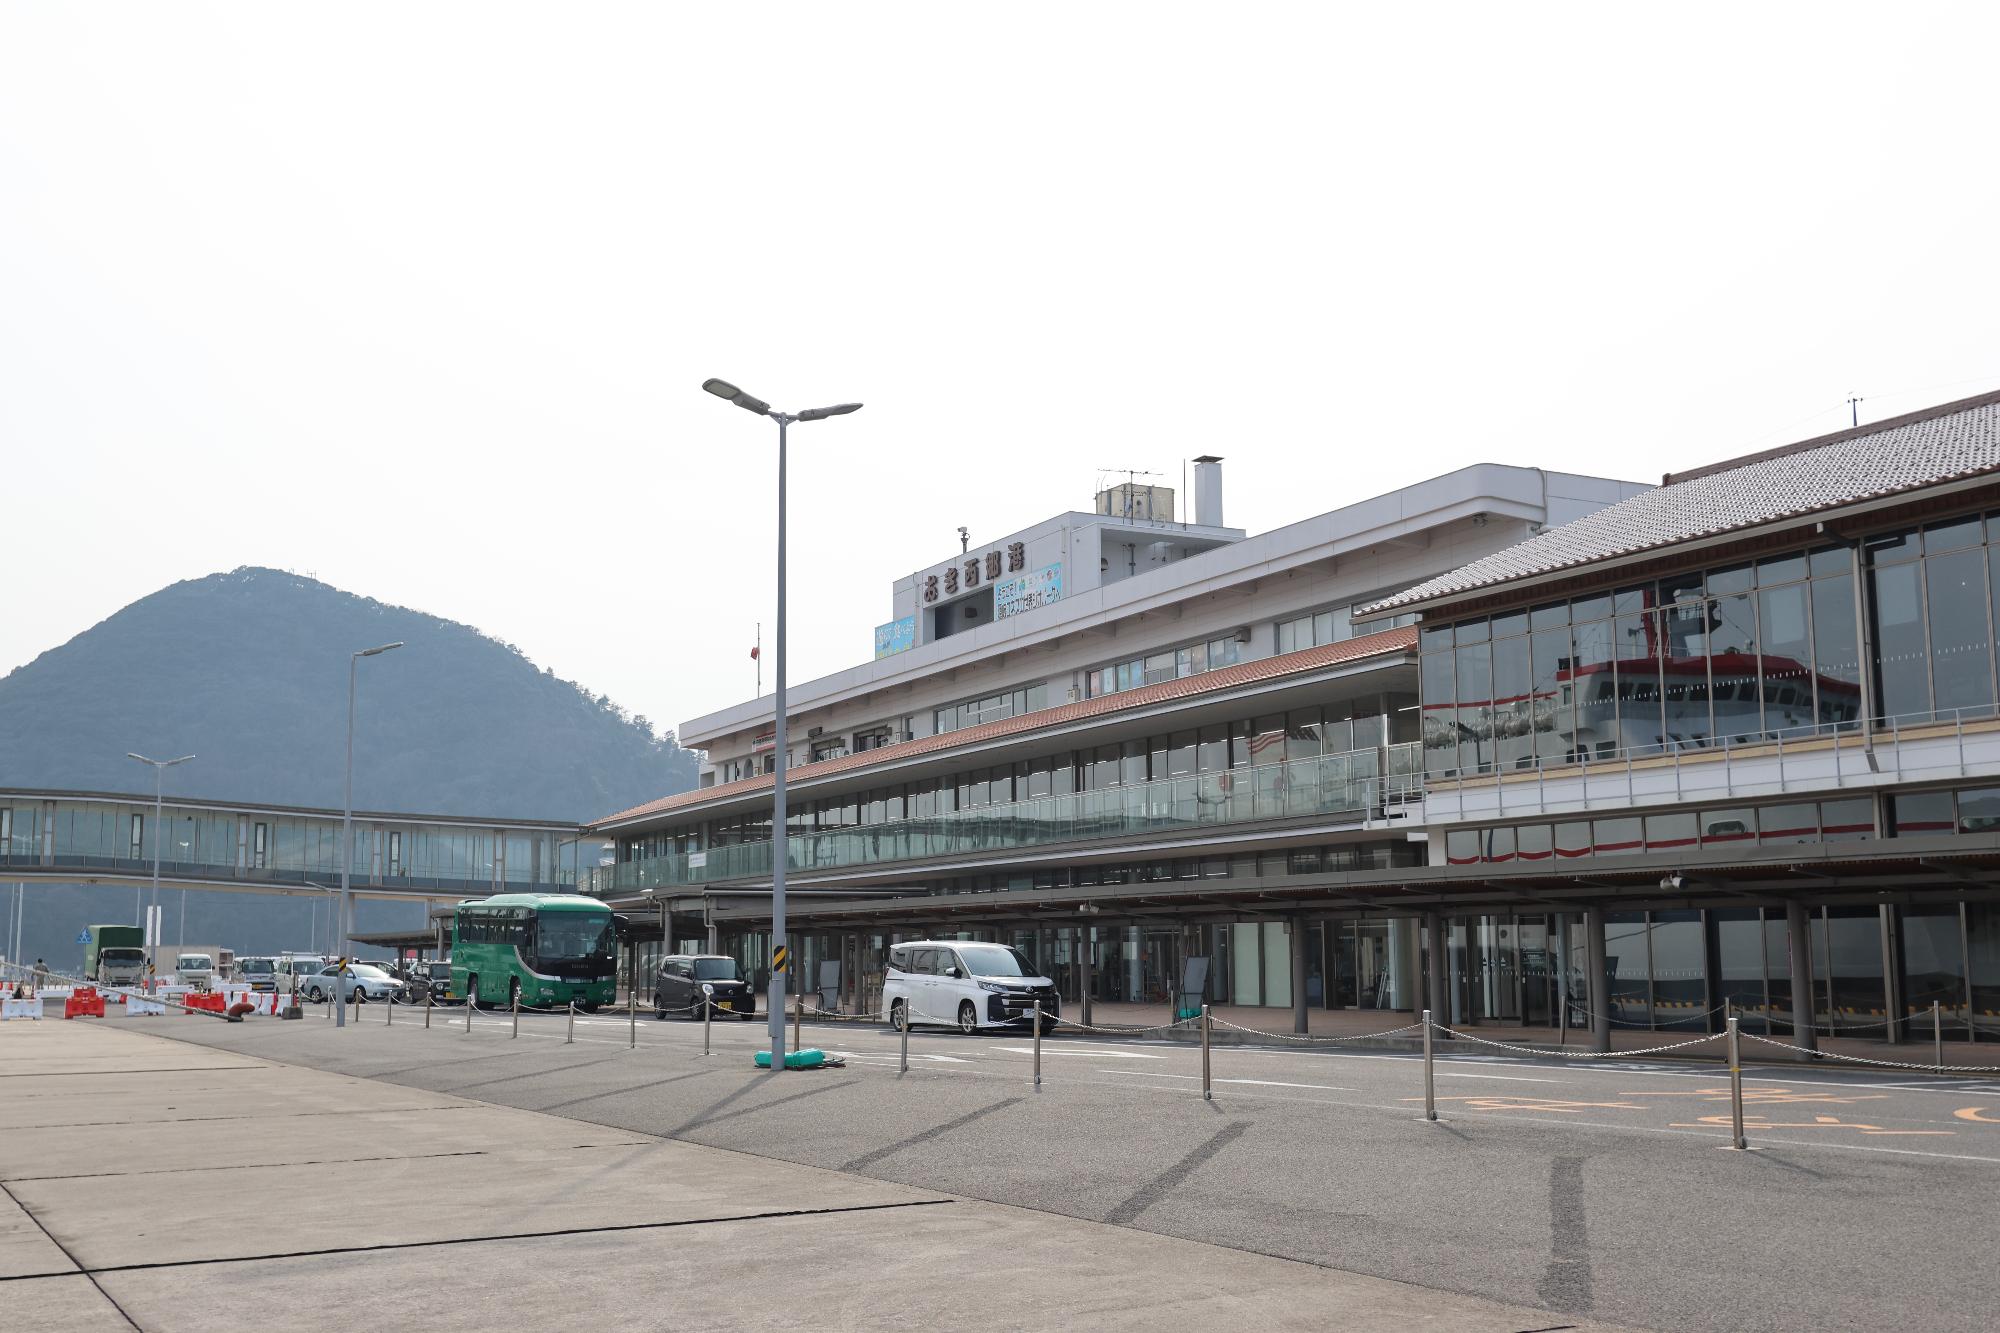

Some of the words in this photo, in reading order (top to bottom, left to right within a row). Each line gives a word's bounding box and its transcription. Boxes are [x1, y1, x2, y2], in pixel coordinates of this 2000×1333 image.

[924, 542, 1025, 602] おき西郷港
